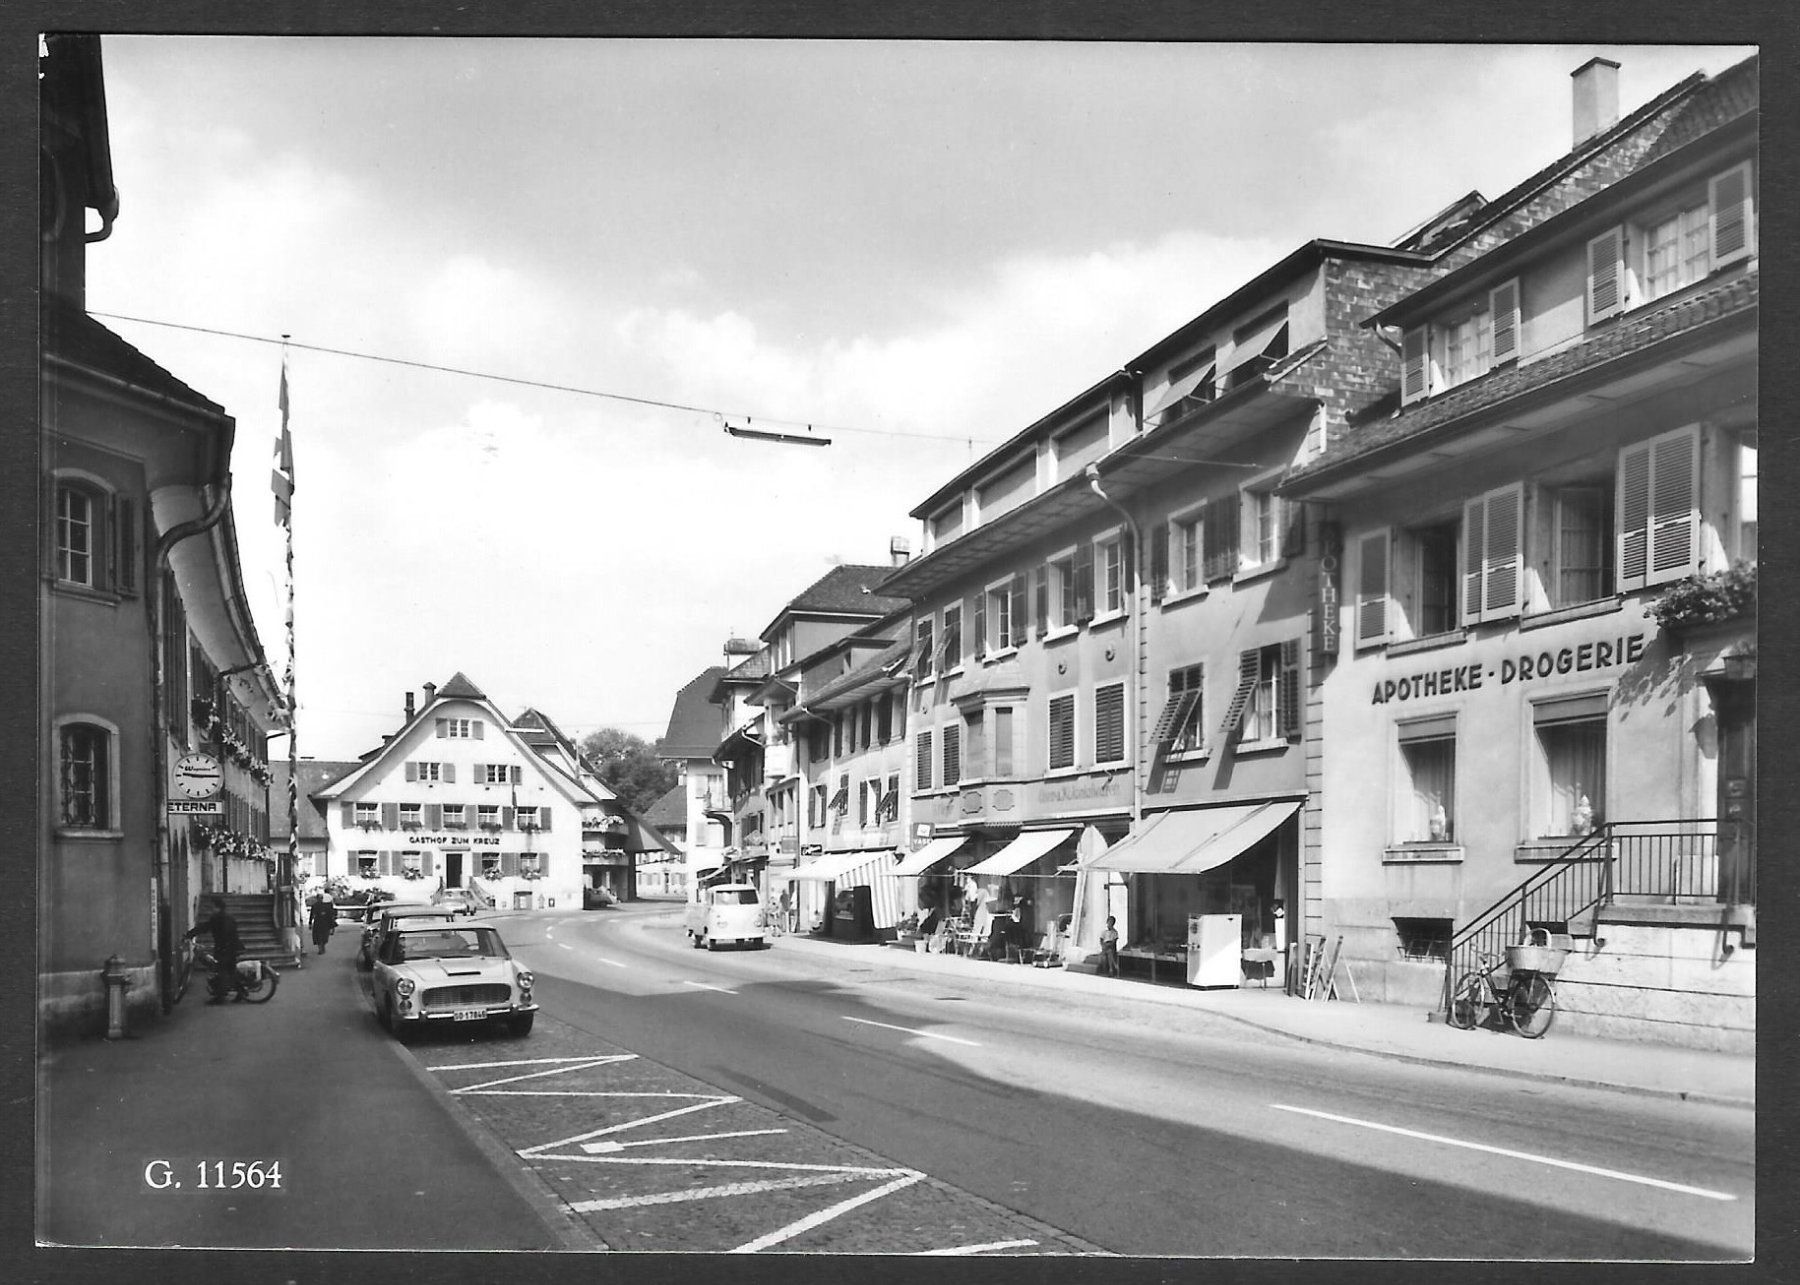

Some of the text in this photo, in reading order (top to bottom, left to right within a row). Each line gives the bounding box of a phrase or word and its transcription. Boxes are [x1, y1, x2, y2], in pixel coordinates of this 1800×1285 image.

[1371, 663, 1483, 705] APOTHEKE
[1501, 633, 1644, 685] DROGERIE
[167, 802, 217, 811] ETERNA
[409, 836, 448, 844] GASTHOF
[451, 837, 469, 845] ZUM
